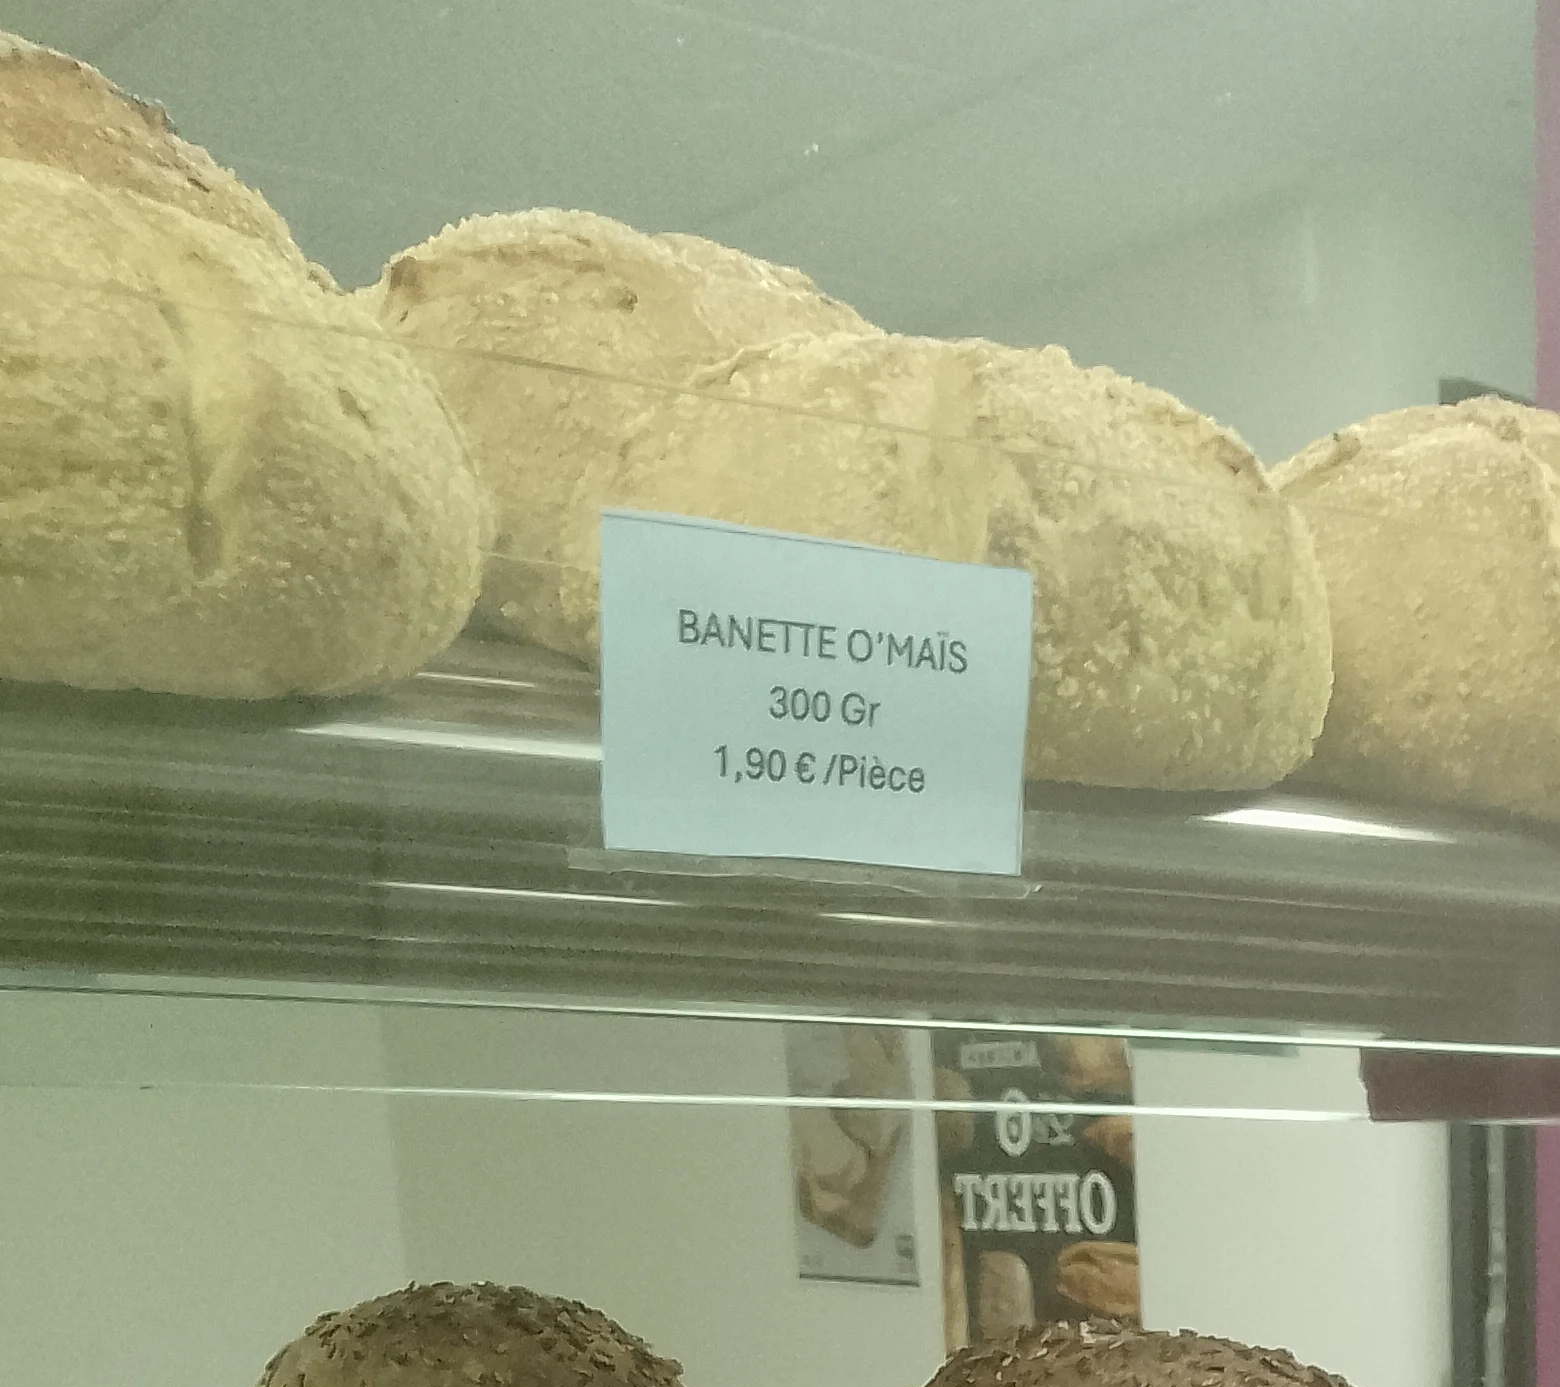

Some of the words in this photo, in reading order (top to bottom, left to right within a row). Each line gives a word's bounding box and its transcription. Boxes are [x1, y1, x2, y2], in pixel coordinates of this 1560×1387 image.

[677, 608, 837, 661] BANETTE
[847, 628, 969, 674] O'MAÏS
[769, 685, 831, 724] 300
[841, 692, 882, 728] Gr
[713, 744, 788, 785] 1,90
[793, 752, 817, 786] €
[822, 752, 927, 794] /Pièce
